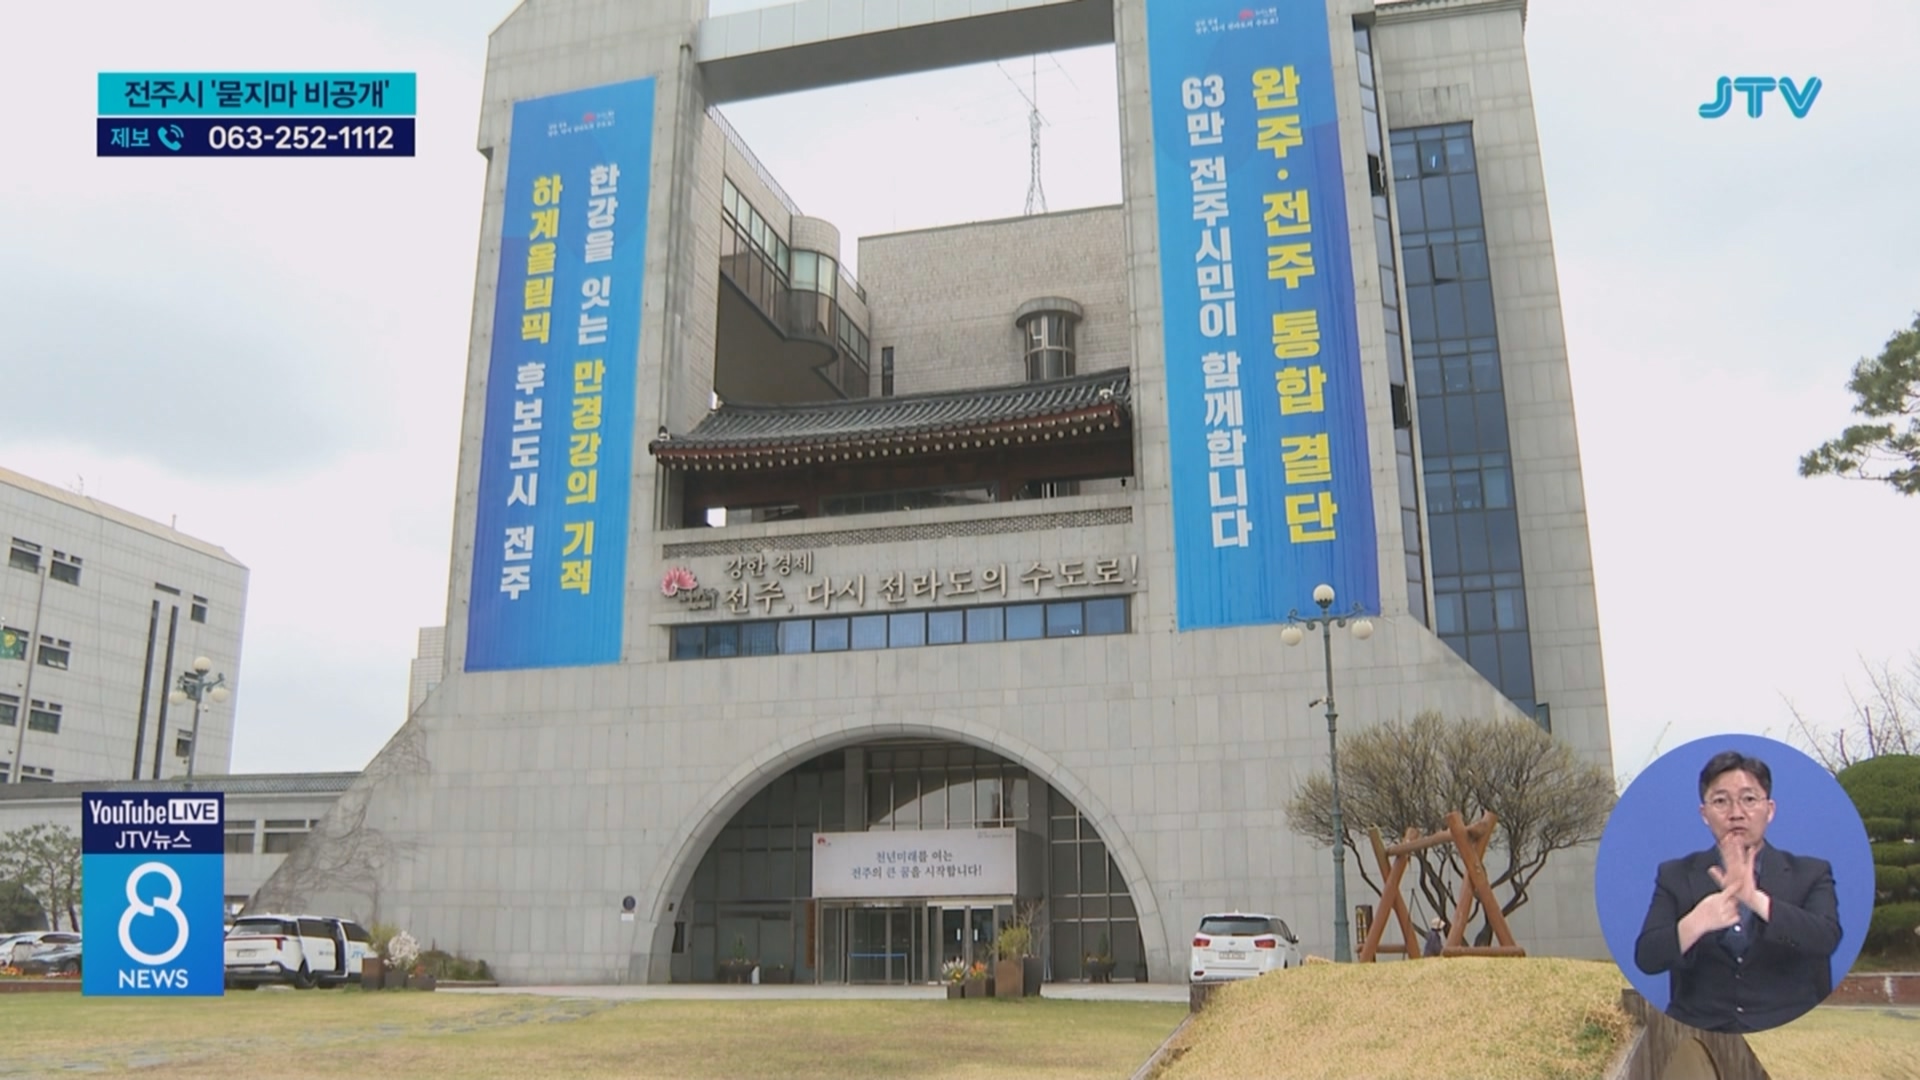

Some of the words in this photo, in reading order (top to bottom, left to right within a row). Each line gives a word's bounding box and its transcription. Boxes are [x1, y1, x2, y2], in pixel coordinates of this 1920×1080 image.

[1181, 75, 1225, 147] 63만
[584, 164, 620, 263] 한강을
[1252, 65, 1316, 289] 완주·전주
[521, 174, 563, 344] 하계올림픽
[1190, 156, 1237, 337] 전주시민이
[578, 276, 611, 345] 잇는
[1272, 310, 1327, 416] 통합
[507, 362, 546, 506] 후보도시
[565, 359, 606, 504] 만경강의
[1201, 351, 1253, 548] 함께합니다
[1281, 433, 1338, 544] 결단
[500, 525, 535, 600] 전주
[560, 520, 595, 595] 기적
[723, 581, 794, 614] 전주,
[807, 573, 866, 609] 다시
[878, 562, 1008, 604] 전라도의
[1021, 554, 1138, 596] 수도로!
[725, 553, 766, 579] 강한
[773, 550, 814, 576] 경제
[852, 866, 882, 879] 전주의
[925, 864, 982, 878] 시작합니다!
